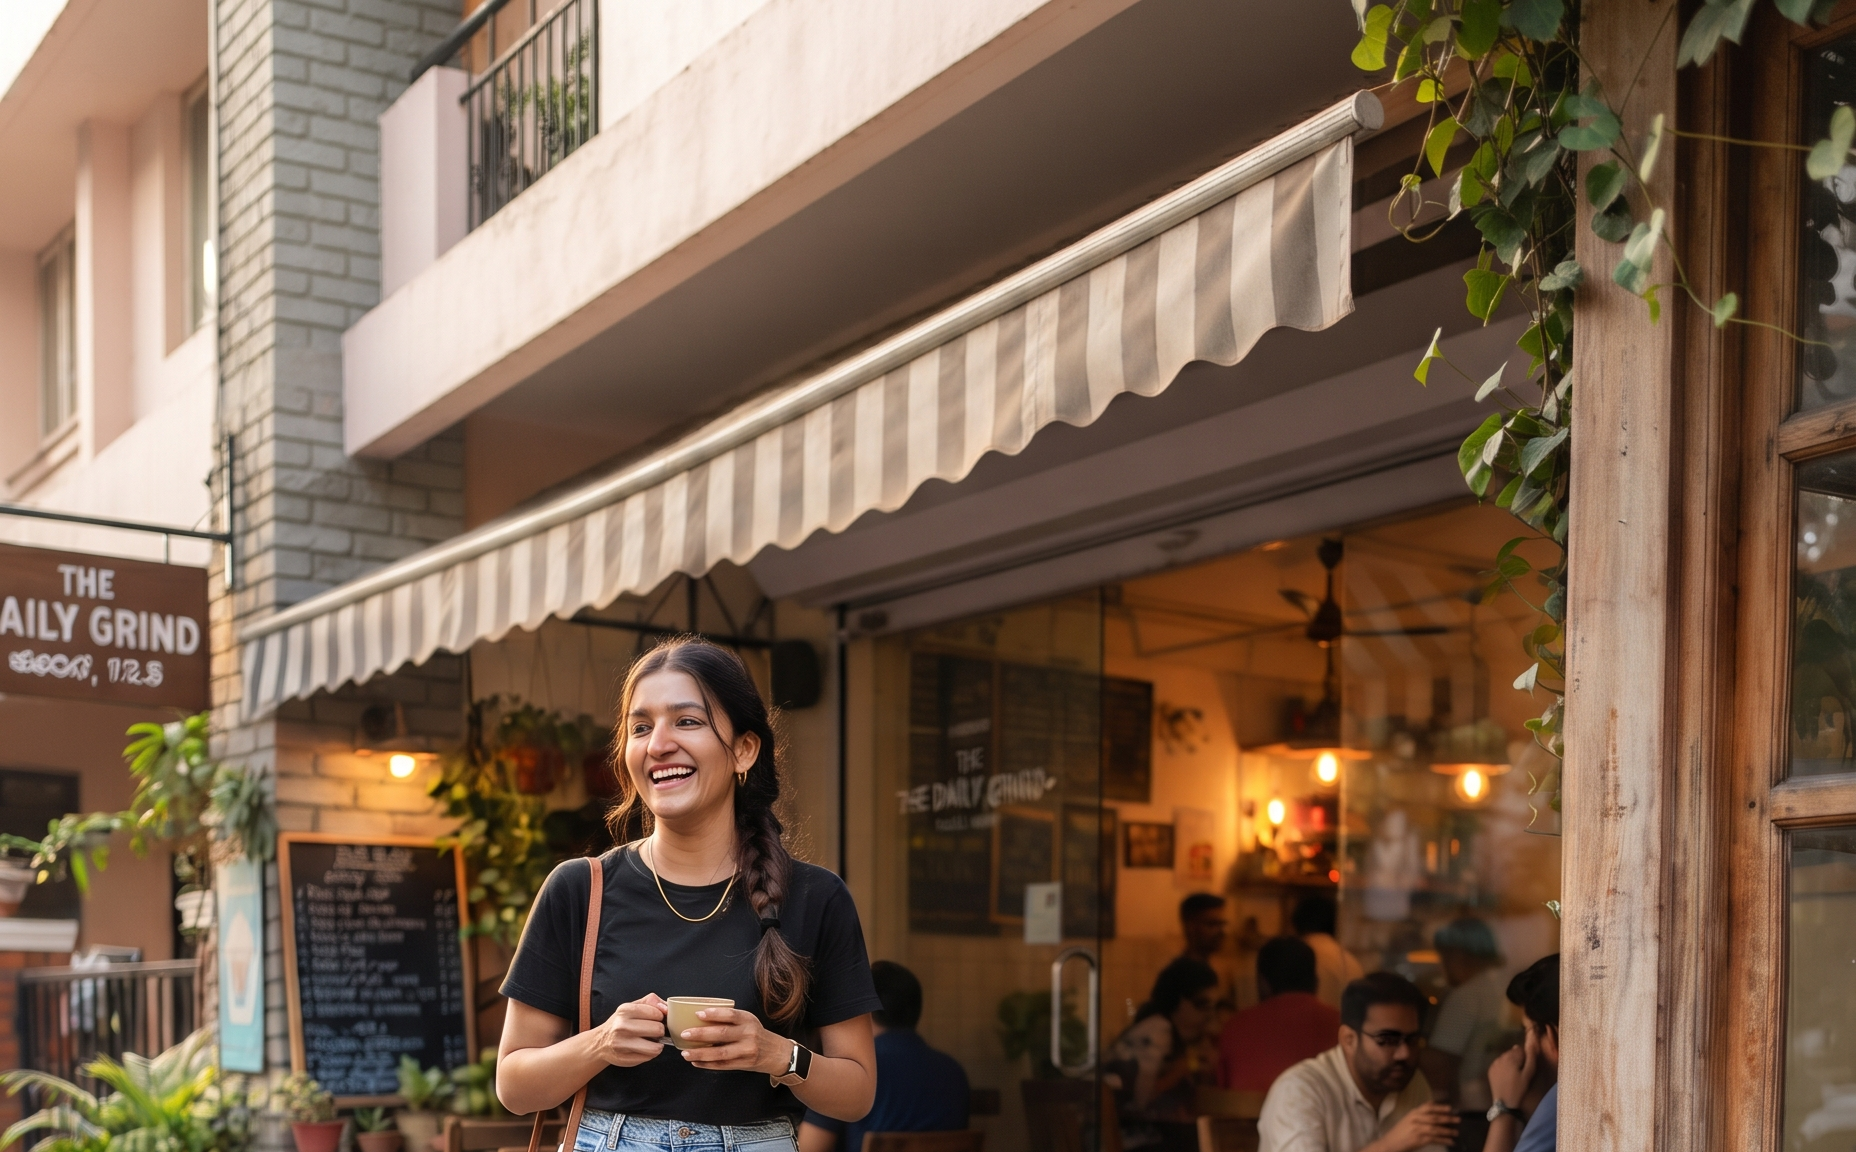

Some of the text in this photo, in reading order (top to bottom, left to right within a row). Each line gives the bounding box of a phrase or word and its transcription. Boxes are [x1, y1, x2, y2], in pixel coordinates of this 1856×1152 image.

[57, 564, 115, 600] THE
[88, 605, 200, 655] GRIND
[955, 747, 984, 774] THE
